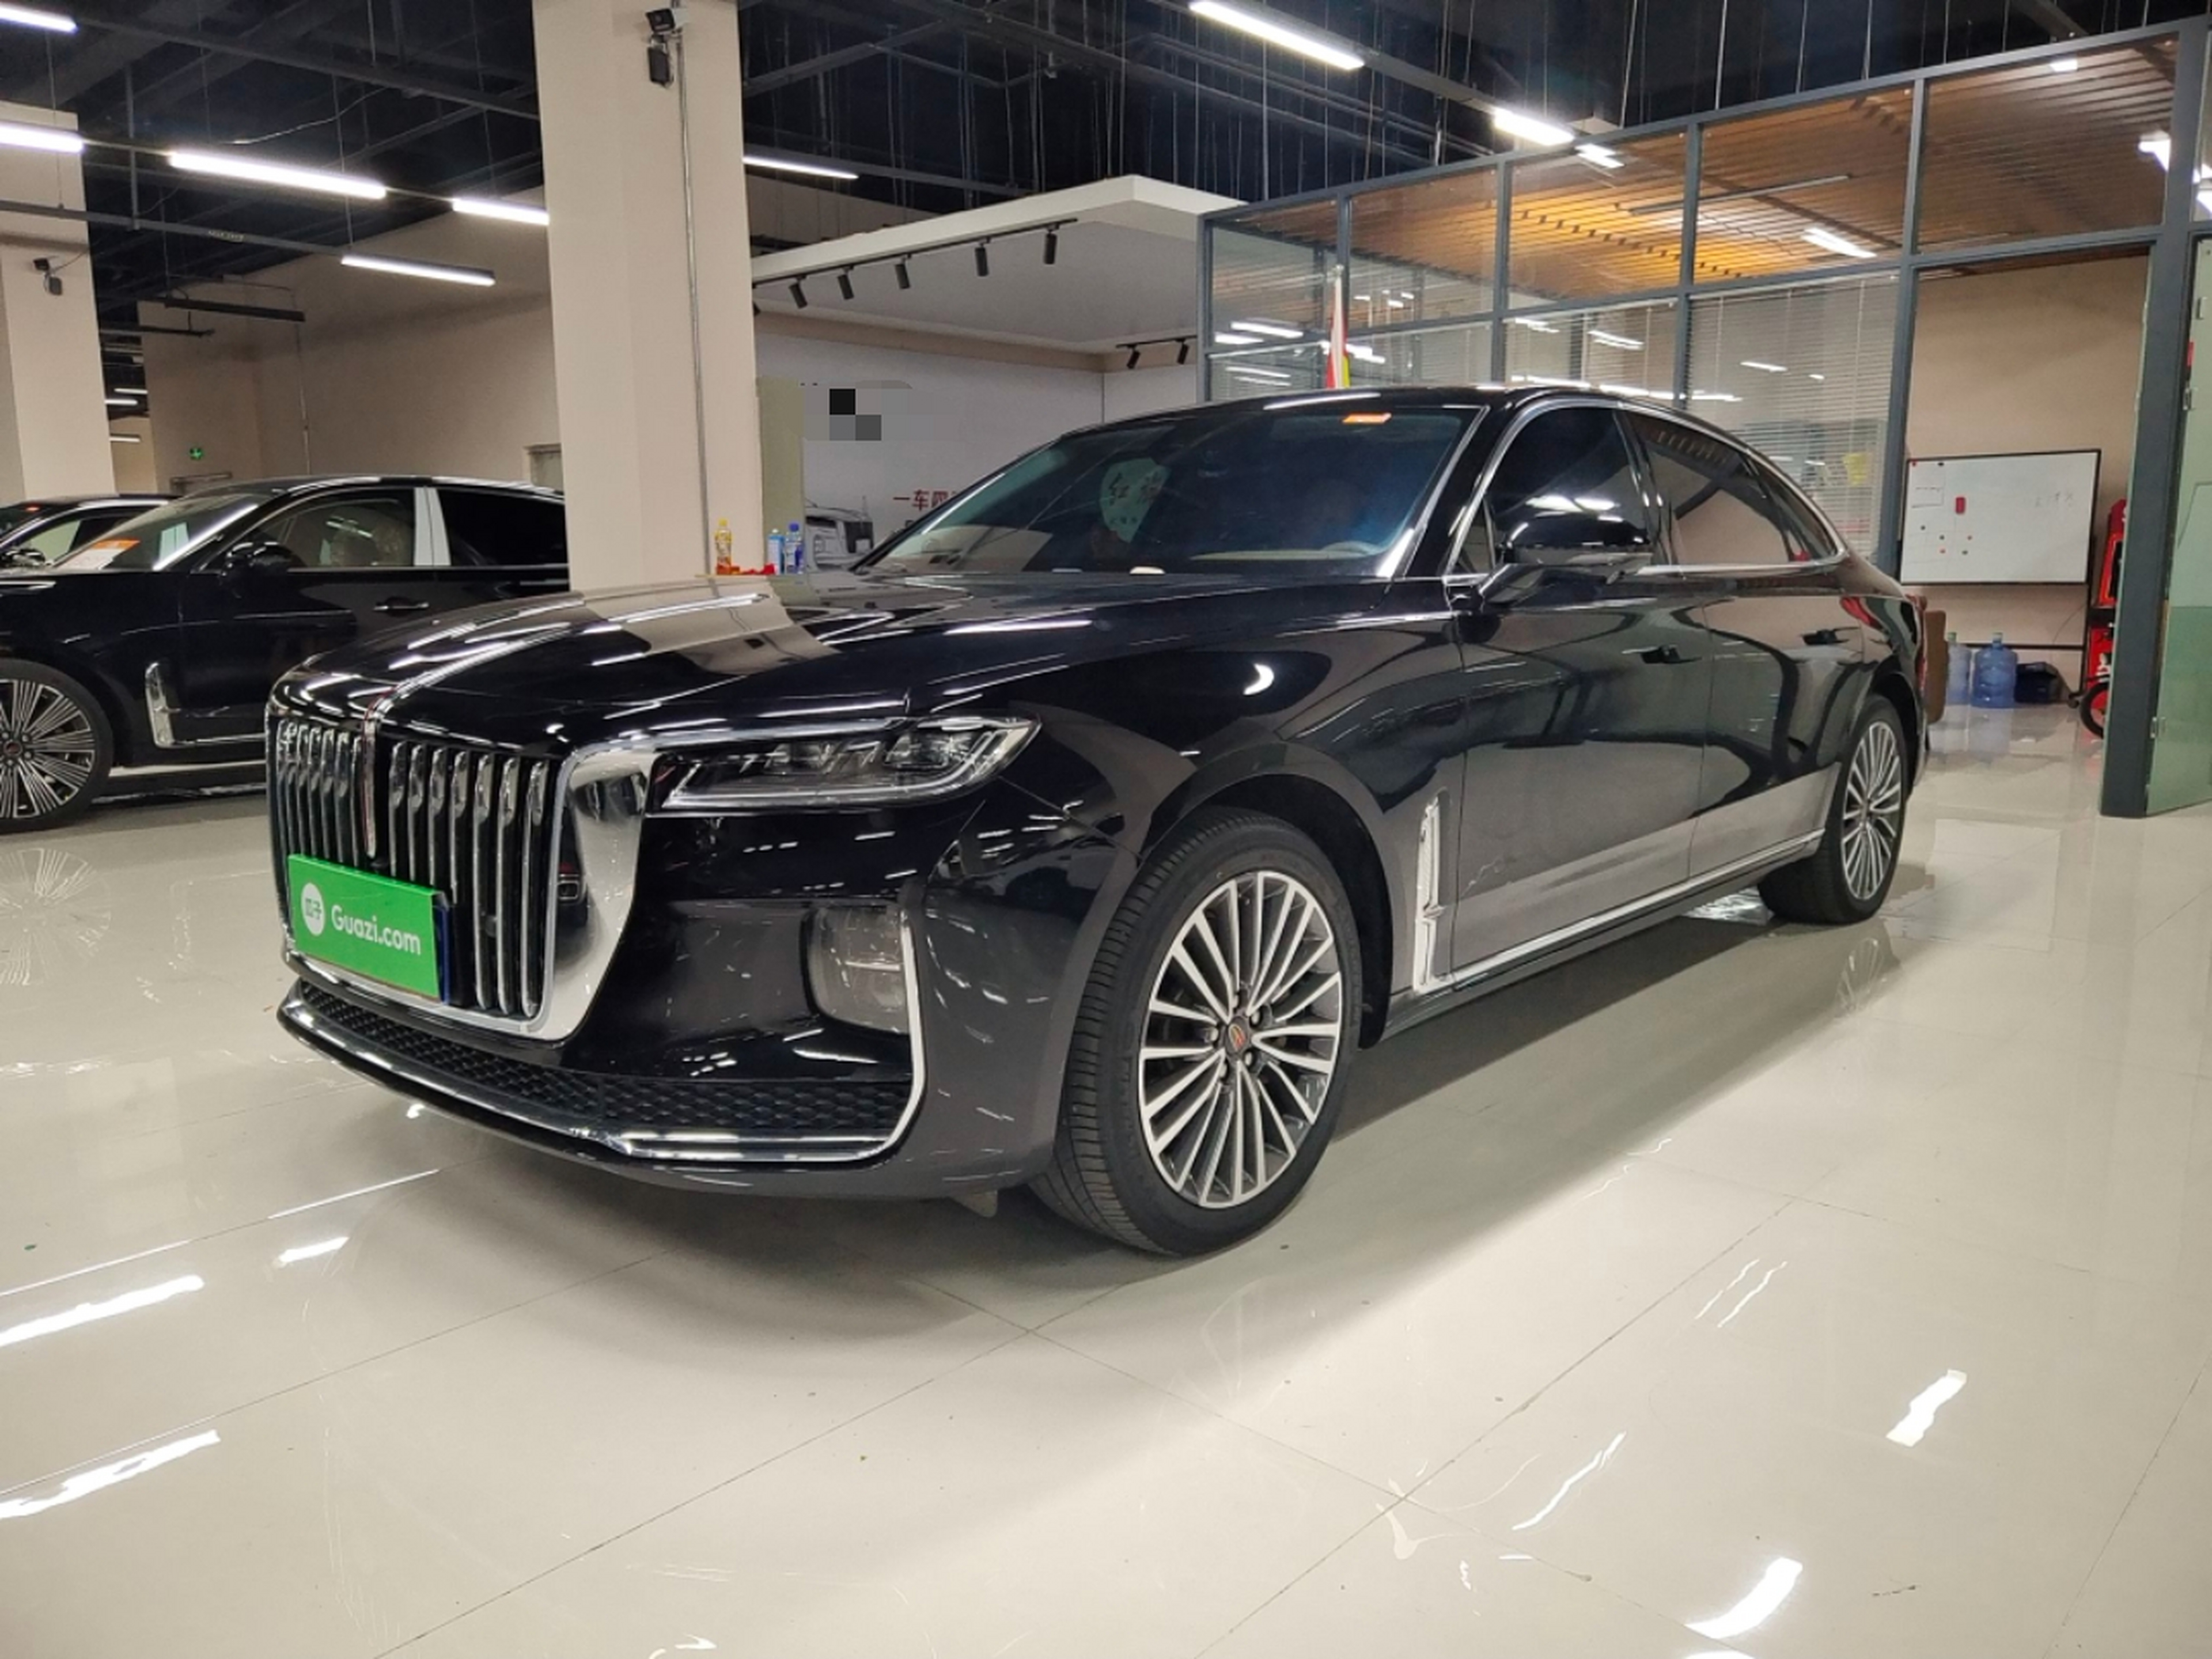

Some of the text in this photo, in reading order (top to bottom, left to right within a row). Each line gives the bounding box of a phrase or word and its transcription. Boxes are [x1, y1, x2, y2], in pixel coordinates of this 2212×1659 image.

[893, 489, 957, 511] 一车四
[331, 904, 421, 956] Guazi.com
